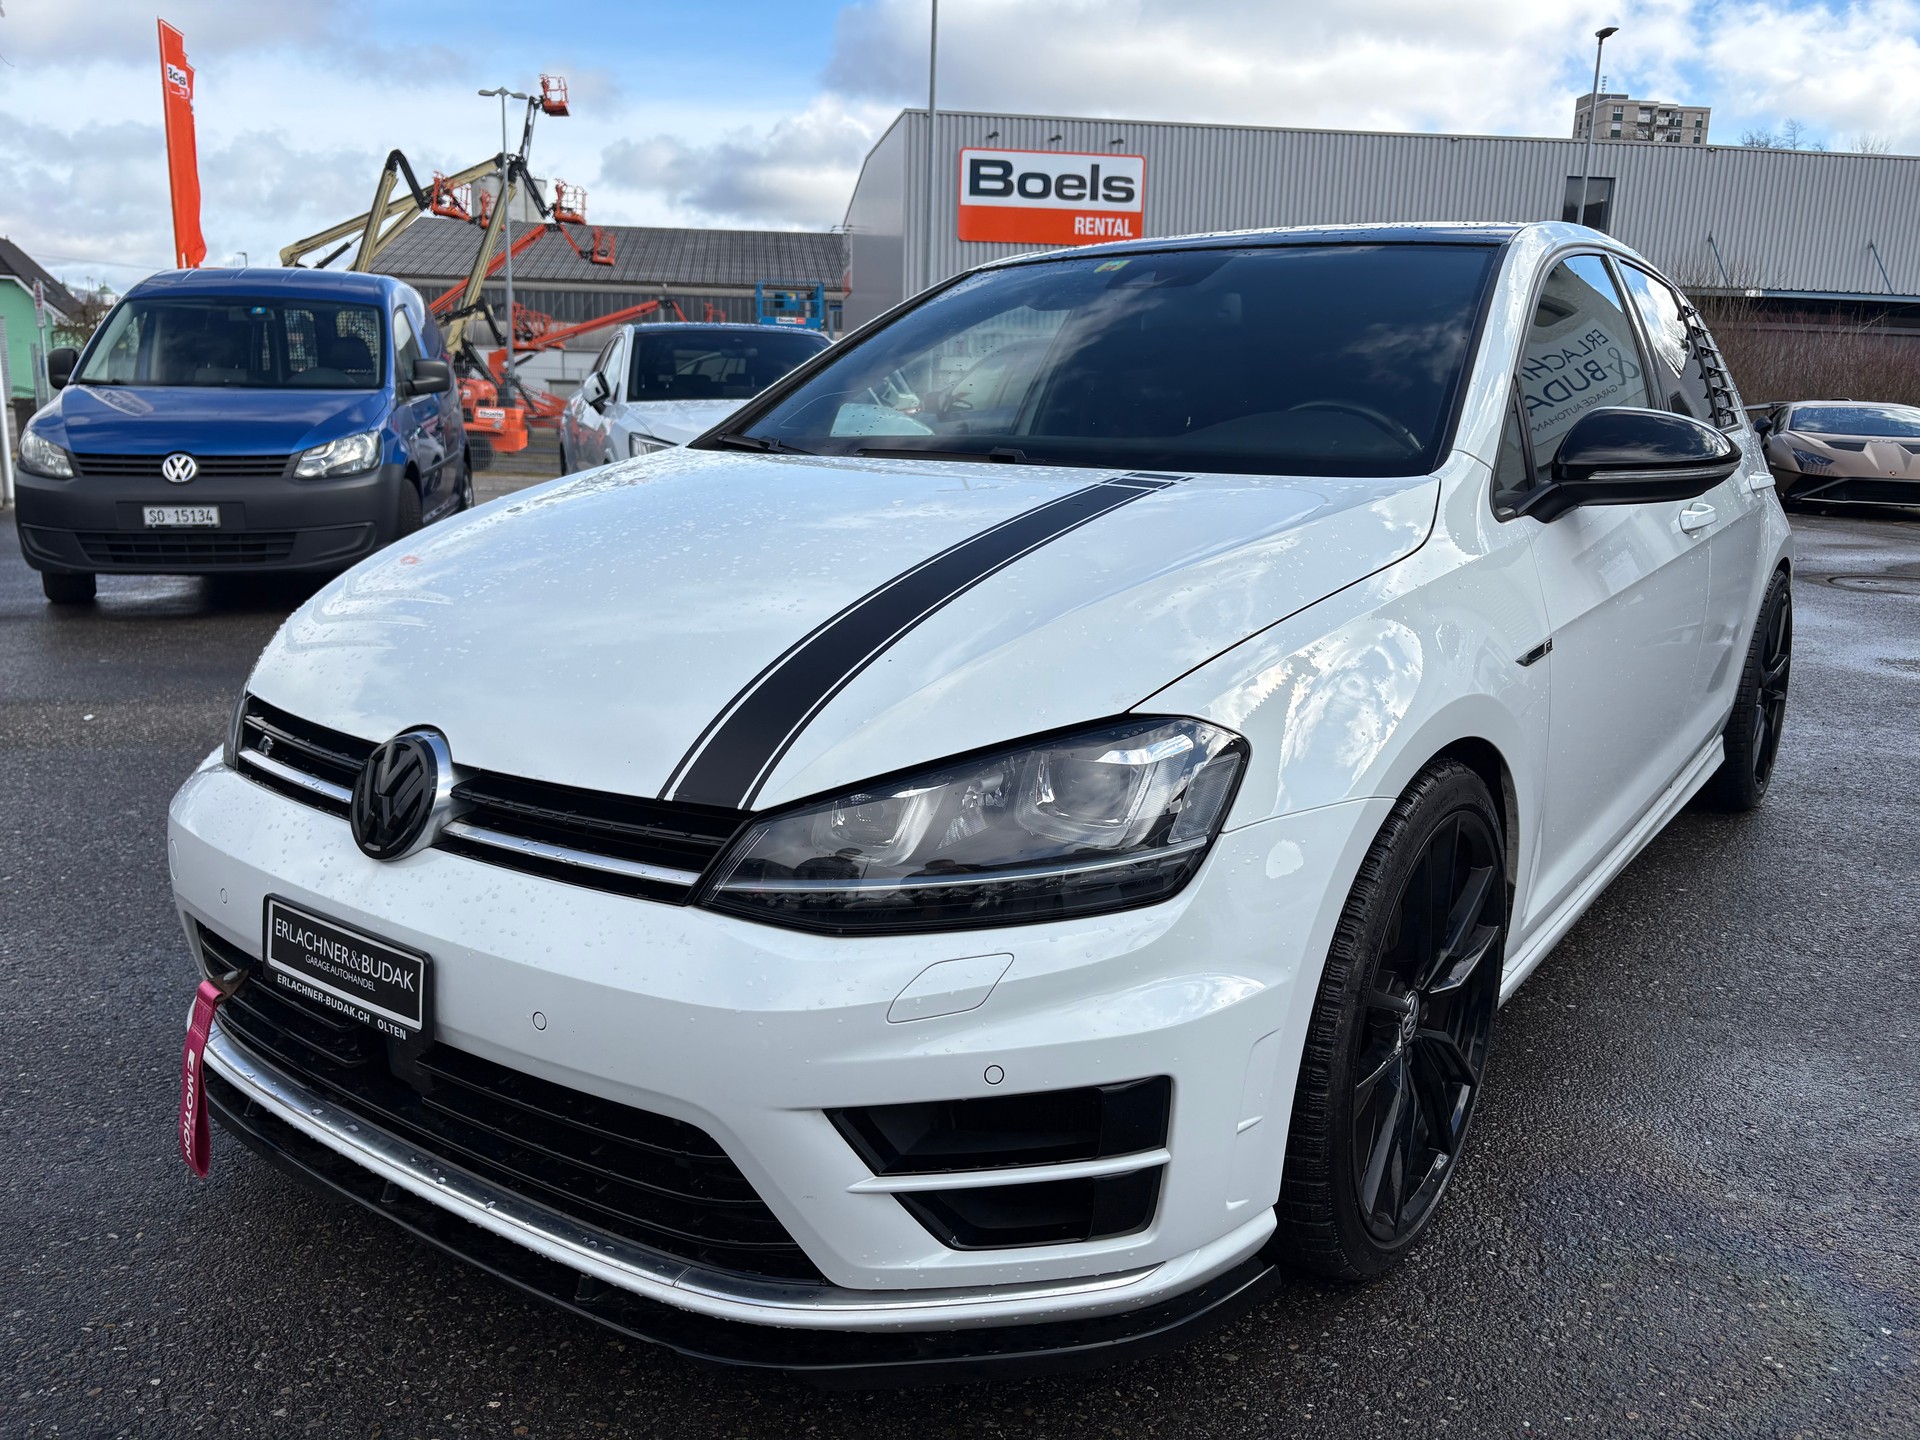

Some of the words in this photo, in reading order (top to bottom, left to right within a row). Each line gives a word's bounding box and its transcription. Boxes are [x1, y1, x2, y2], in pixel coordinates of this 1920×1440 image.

[969, 158, 1135, 203] Boels
[1074, 216, 1133, 237] RENTAL
[149, 509, 165, 523] SO
[174, 509, 213, 523] 15134
[275, 917, 415, 992] ERLACHNER&BUDAK
[277, 973, 370, 1023] ERLACHNER-BUDAK.CH
[377, 1018, 407, 1040] OLTEN
